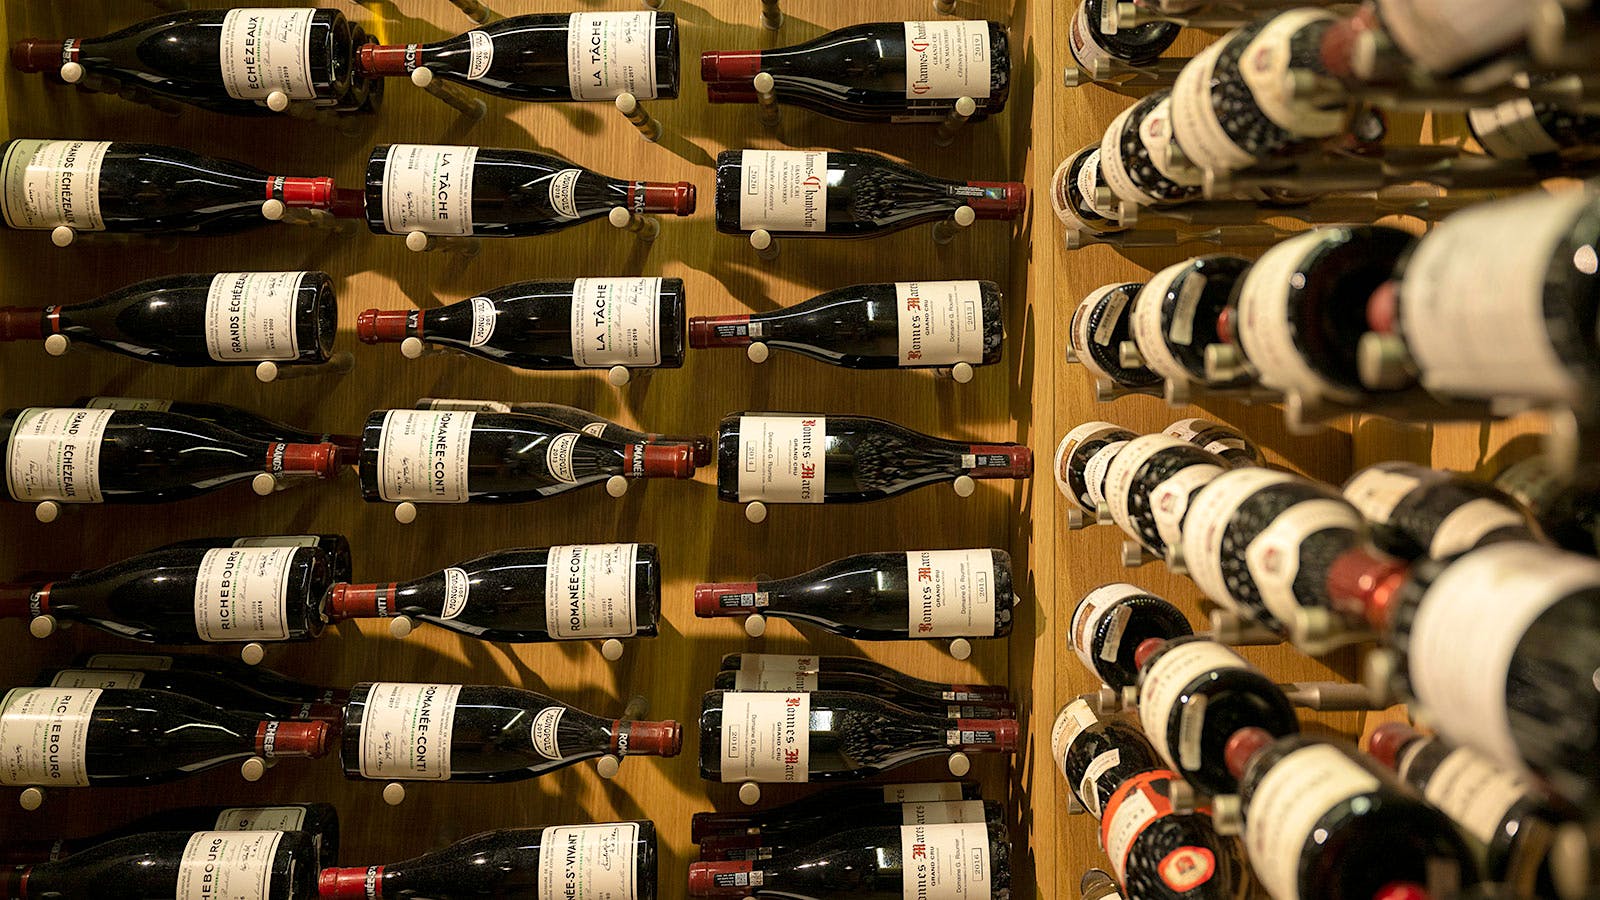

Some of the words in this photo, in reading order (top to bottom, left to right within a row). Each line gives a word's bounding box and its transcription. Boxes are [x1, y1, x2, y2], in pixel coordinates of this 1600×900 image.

[244, 16, 259, 89] ÉCHÉZEAUX
[589, 21, 602, 64] TÂCHE
[592, 70, 602, 86] LA
[64, 142, 84, 168] GRANDS
[442, 154, 452, 166] LA
[62, 172, 74, 224] ÉCHÉZEAUX
[439, 172, 450, 220] TÂCHE
[562, 174, 572, 210] MONOPOLE
[408, 313, 418, 328] LA
[593, 285, 607, 327] TÂCHE
[230, 316, 242, 352] GRANDS
[596, 333, 605, 351] LA
[63, 444, 76, 497] ÉCHÉZEAUX
[435, 413, 452, 496] ROMANÉE-CONTI
[559, 438, 570, 476] MONOPOLE
[220, 551, 240, 630] RICHEBOURG
[568, 547, 582, 631] ROMANÉE-CONTI
[417, 686, 438, 772] ROMANÉE-CONTI
[542, 712, 554, 751] MONOPOLE
